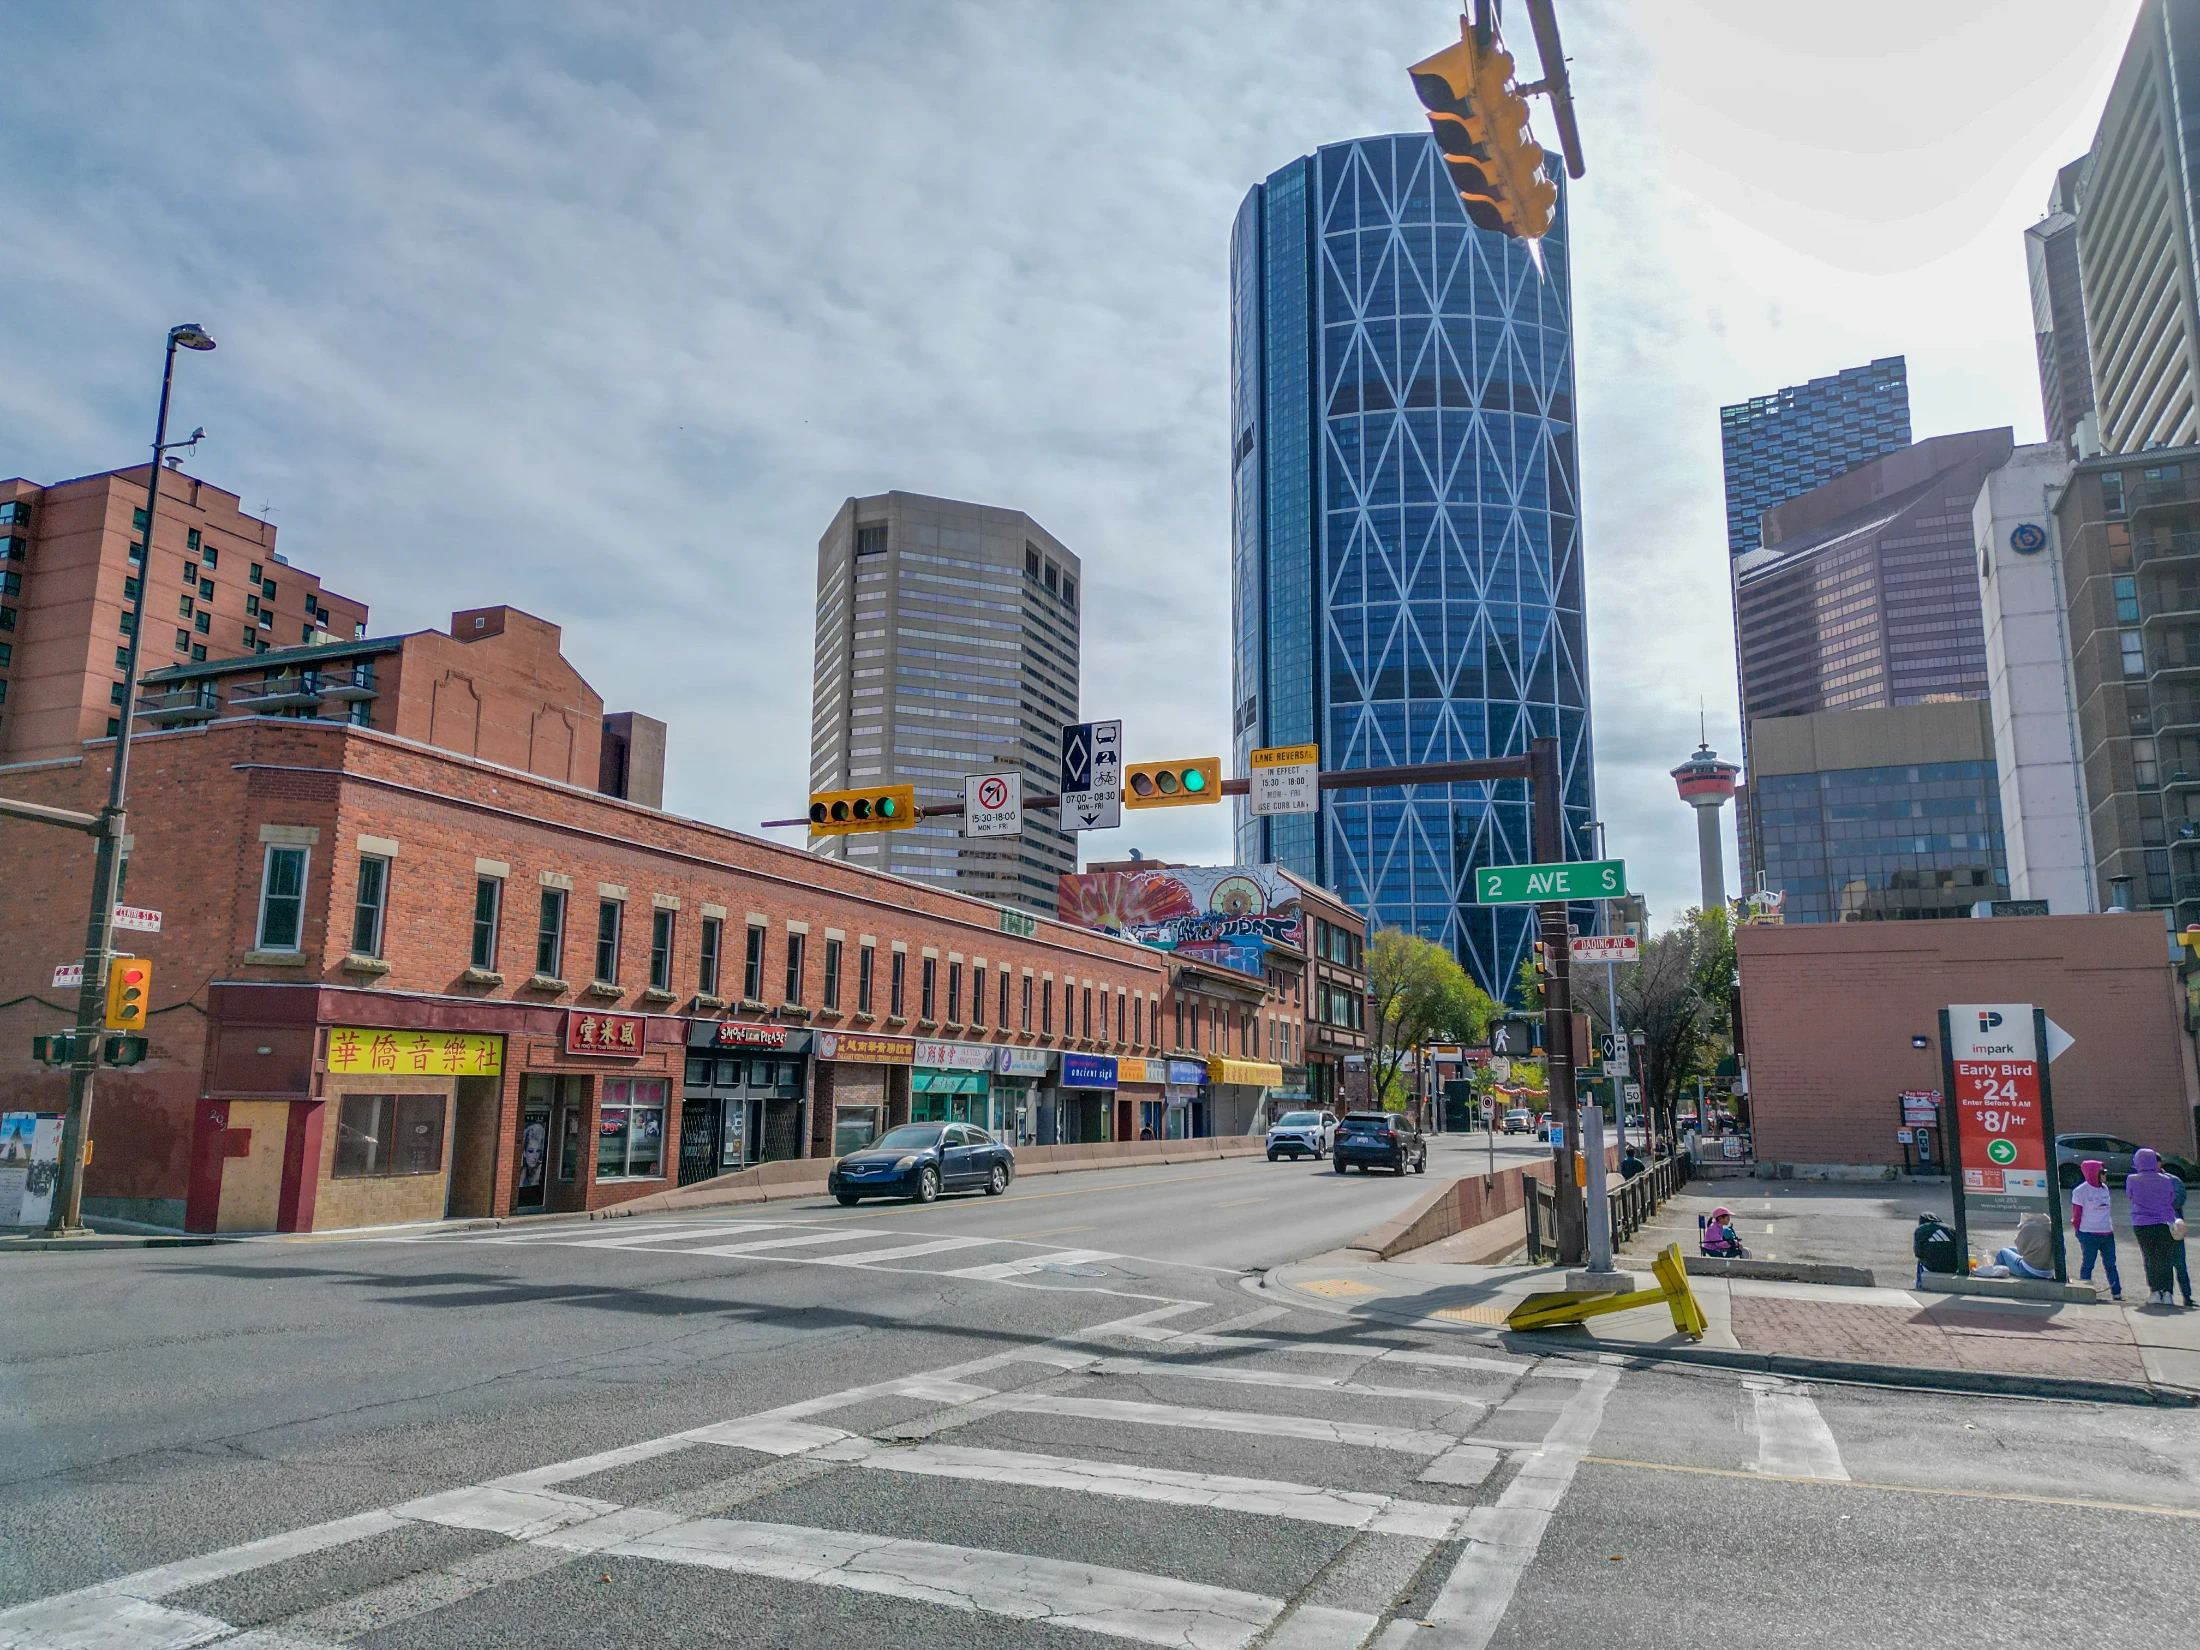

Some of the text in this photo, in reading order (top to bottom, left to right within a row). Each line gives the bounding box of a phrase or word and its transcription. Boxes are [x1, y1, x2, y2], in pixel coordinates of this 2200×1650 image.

[1255, 751, 1313, 762] LANE REVERSAL
[1268, 766, 1300, 776] IN EFFECT
[1262, 779, 1279, 787] 15:30
[1288, 777, 1305, 786] 18:00
[1066, 794, 1086, 804] 07:00
[1094, 792, 1115, 801] 08:30
[1267, 790, 1282, 798] MON
[1274, 802, 1290, 810] CURB
[1488, 868, 1617, 896] 2 AVE S
[1613, 938, 1628, 948] AVE
[760, 1030, 788, 1044] PLEASE!
[331, 1030, 500, 1073] 華僑音樂社
[1972, 1044, 2014, 1056] impark
[1072, 1067, 1097, 1078] ancient
[1960, 1064, 2032, 1078] Early Bird
[1974, 1080, 2018, 1100] $24
[1626, 1092, 1640, 1100] 50
[210, 1110, 227, 1132] 202
